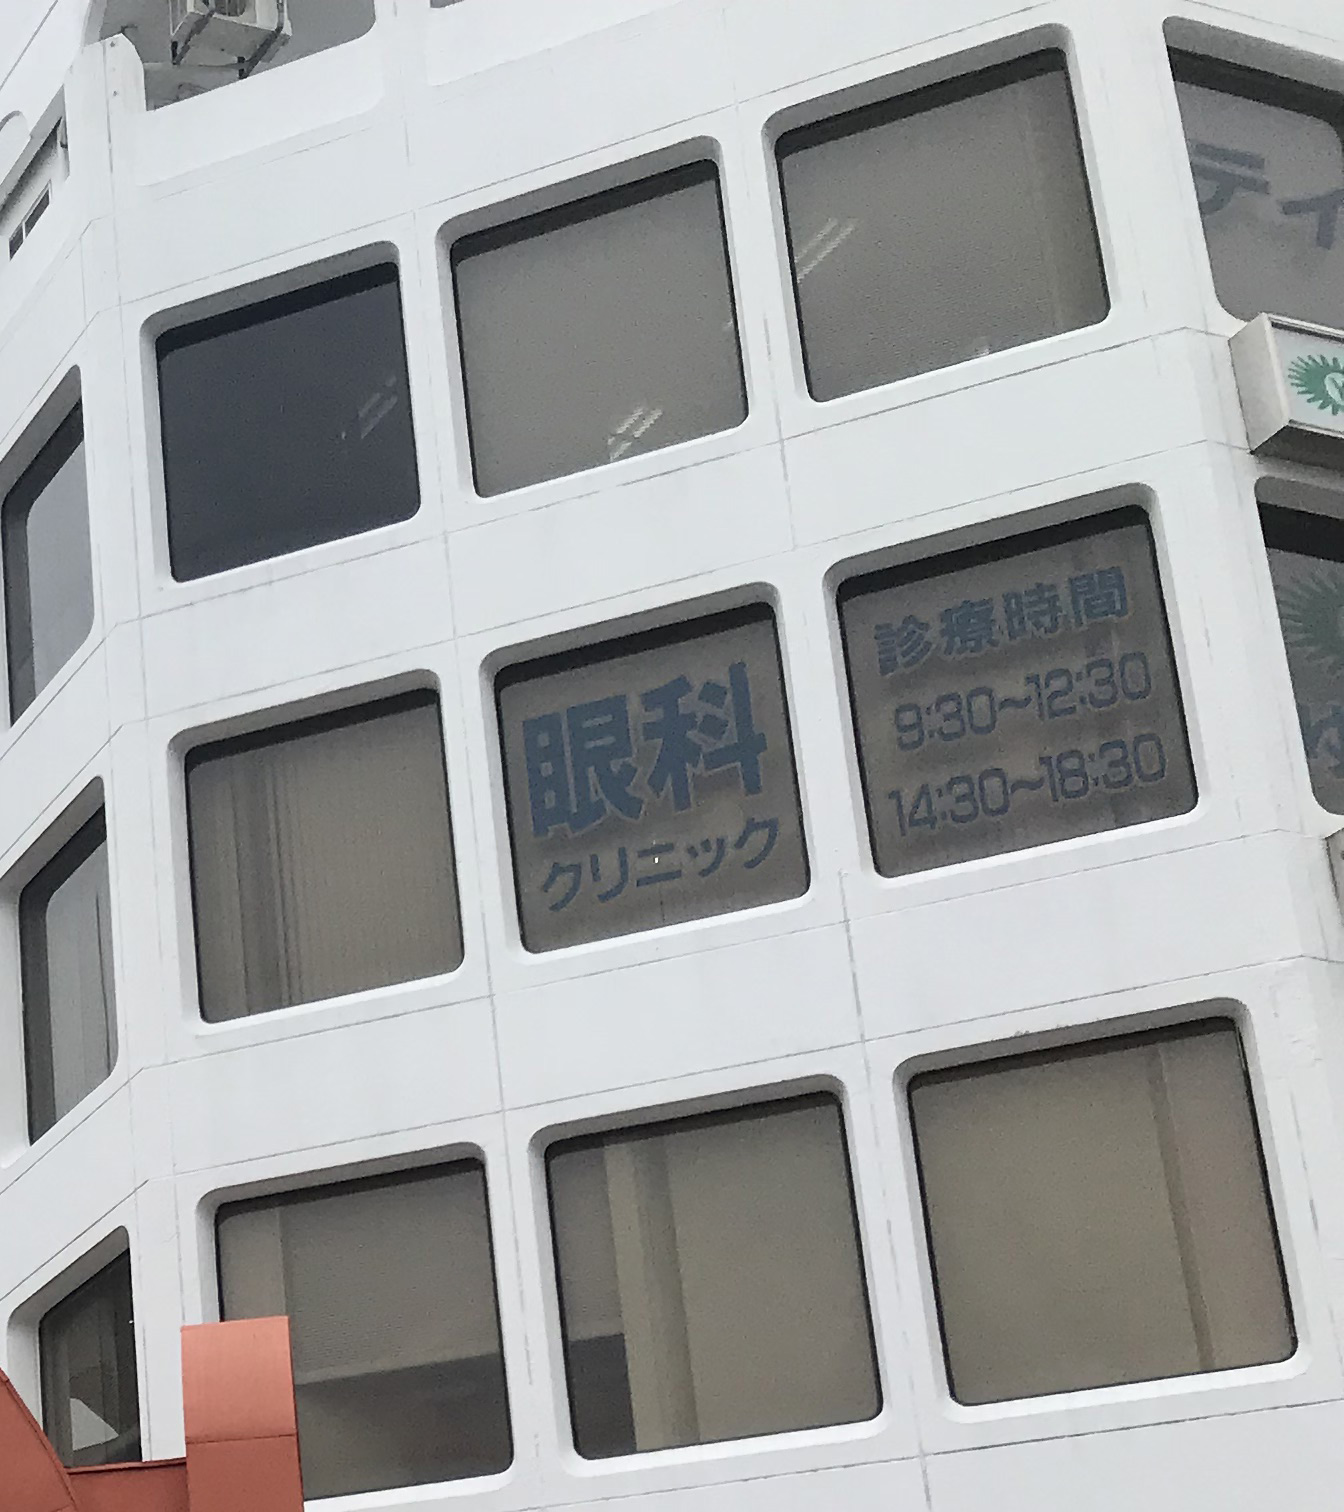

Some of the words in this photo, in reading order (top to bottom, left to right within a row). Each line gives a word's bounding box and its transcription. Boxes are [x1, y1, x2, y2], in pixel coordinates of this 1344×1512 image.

[873, 567, 1129, 677] 診療時間
[523, 661, 767, 837] 眼科
[539, 816, 780, 911] クリニック
